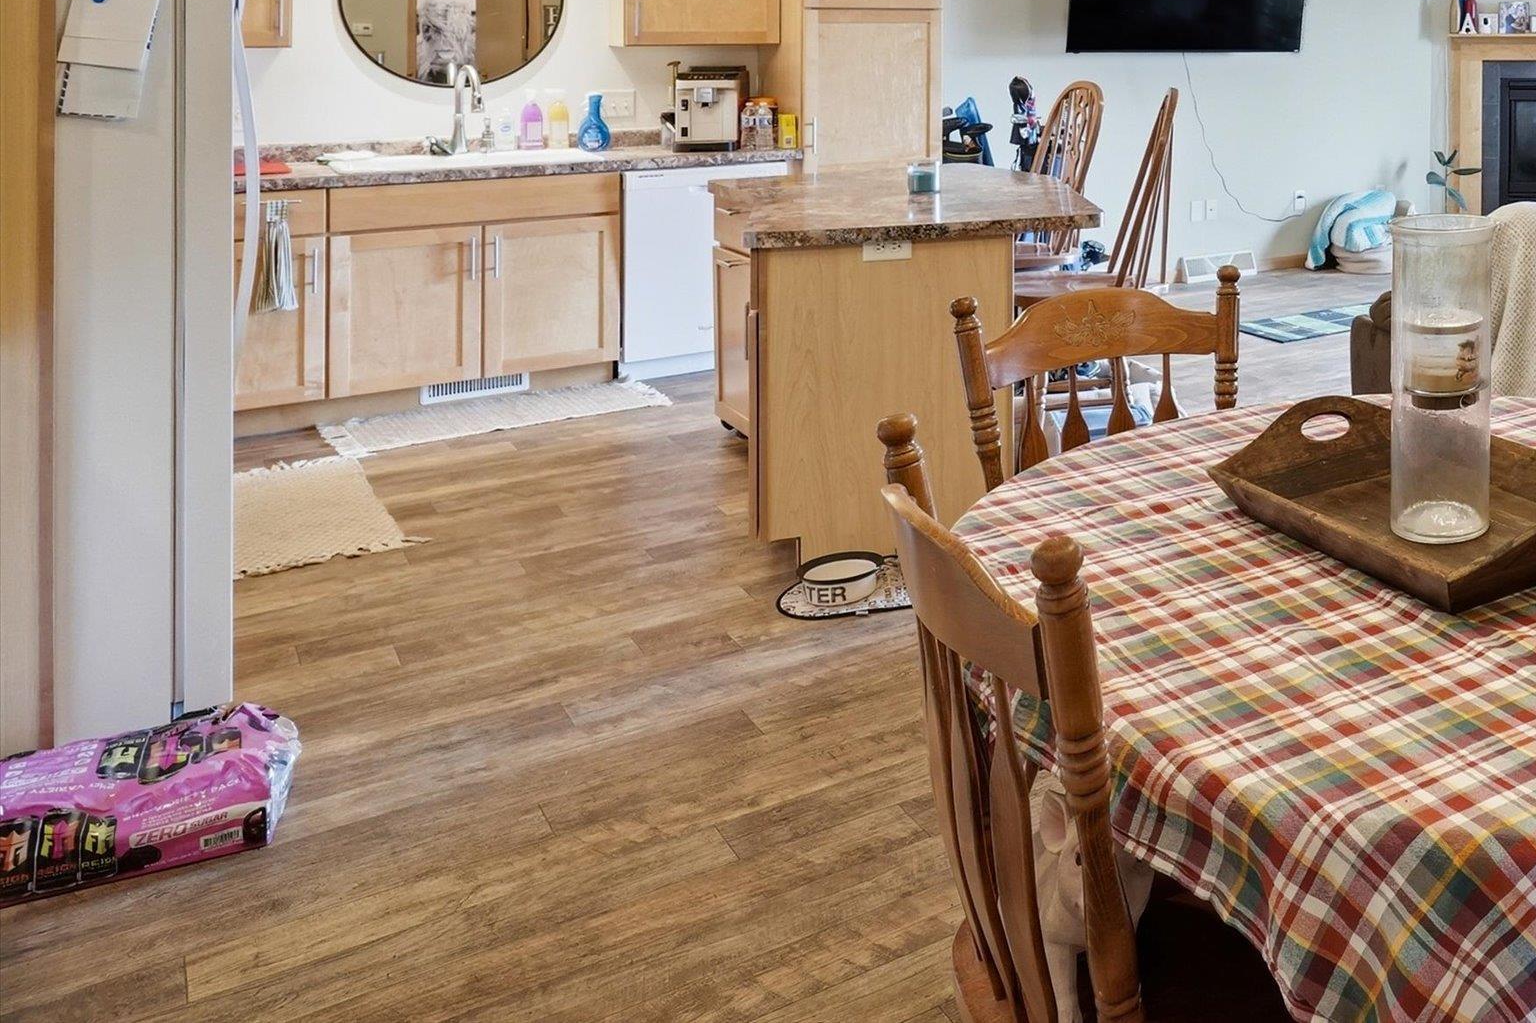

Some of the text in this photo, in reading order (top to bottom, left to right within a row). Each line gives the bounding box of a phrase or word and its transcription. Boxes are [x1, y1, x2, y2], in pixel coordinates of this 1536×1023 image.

[803, 585, 846, 603] TER
[134, 822, 187, 846] ZERO
[189, 811, 228, 829] SUGAR
